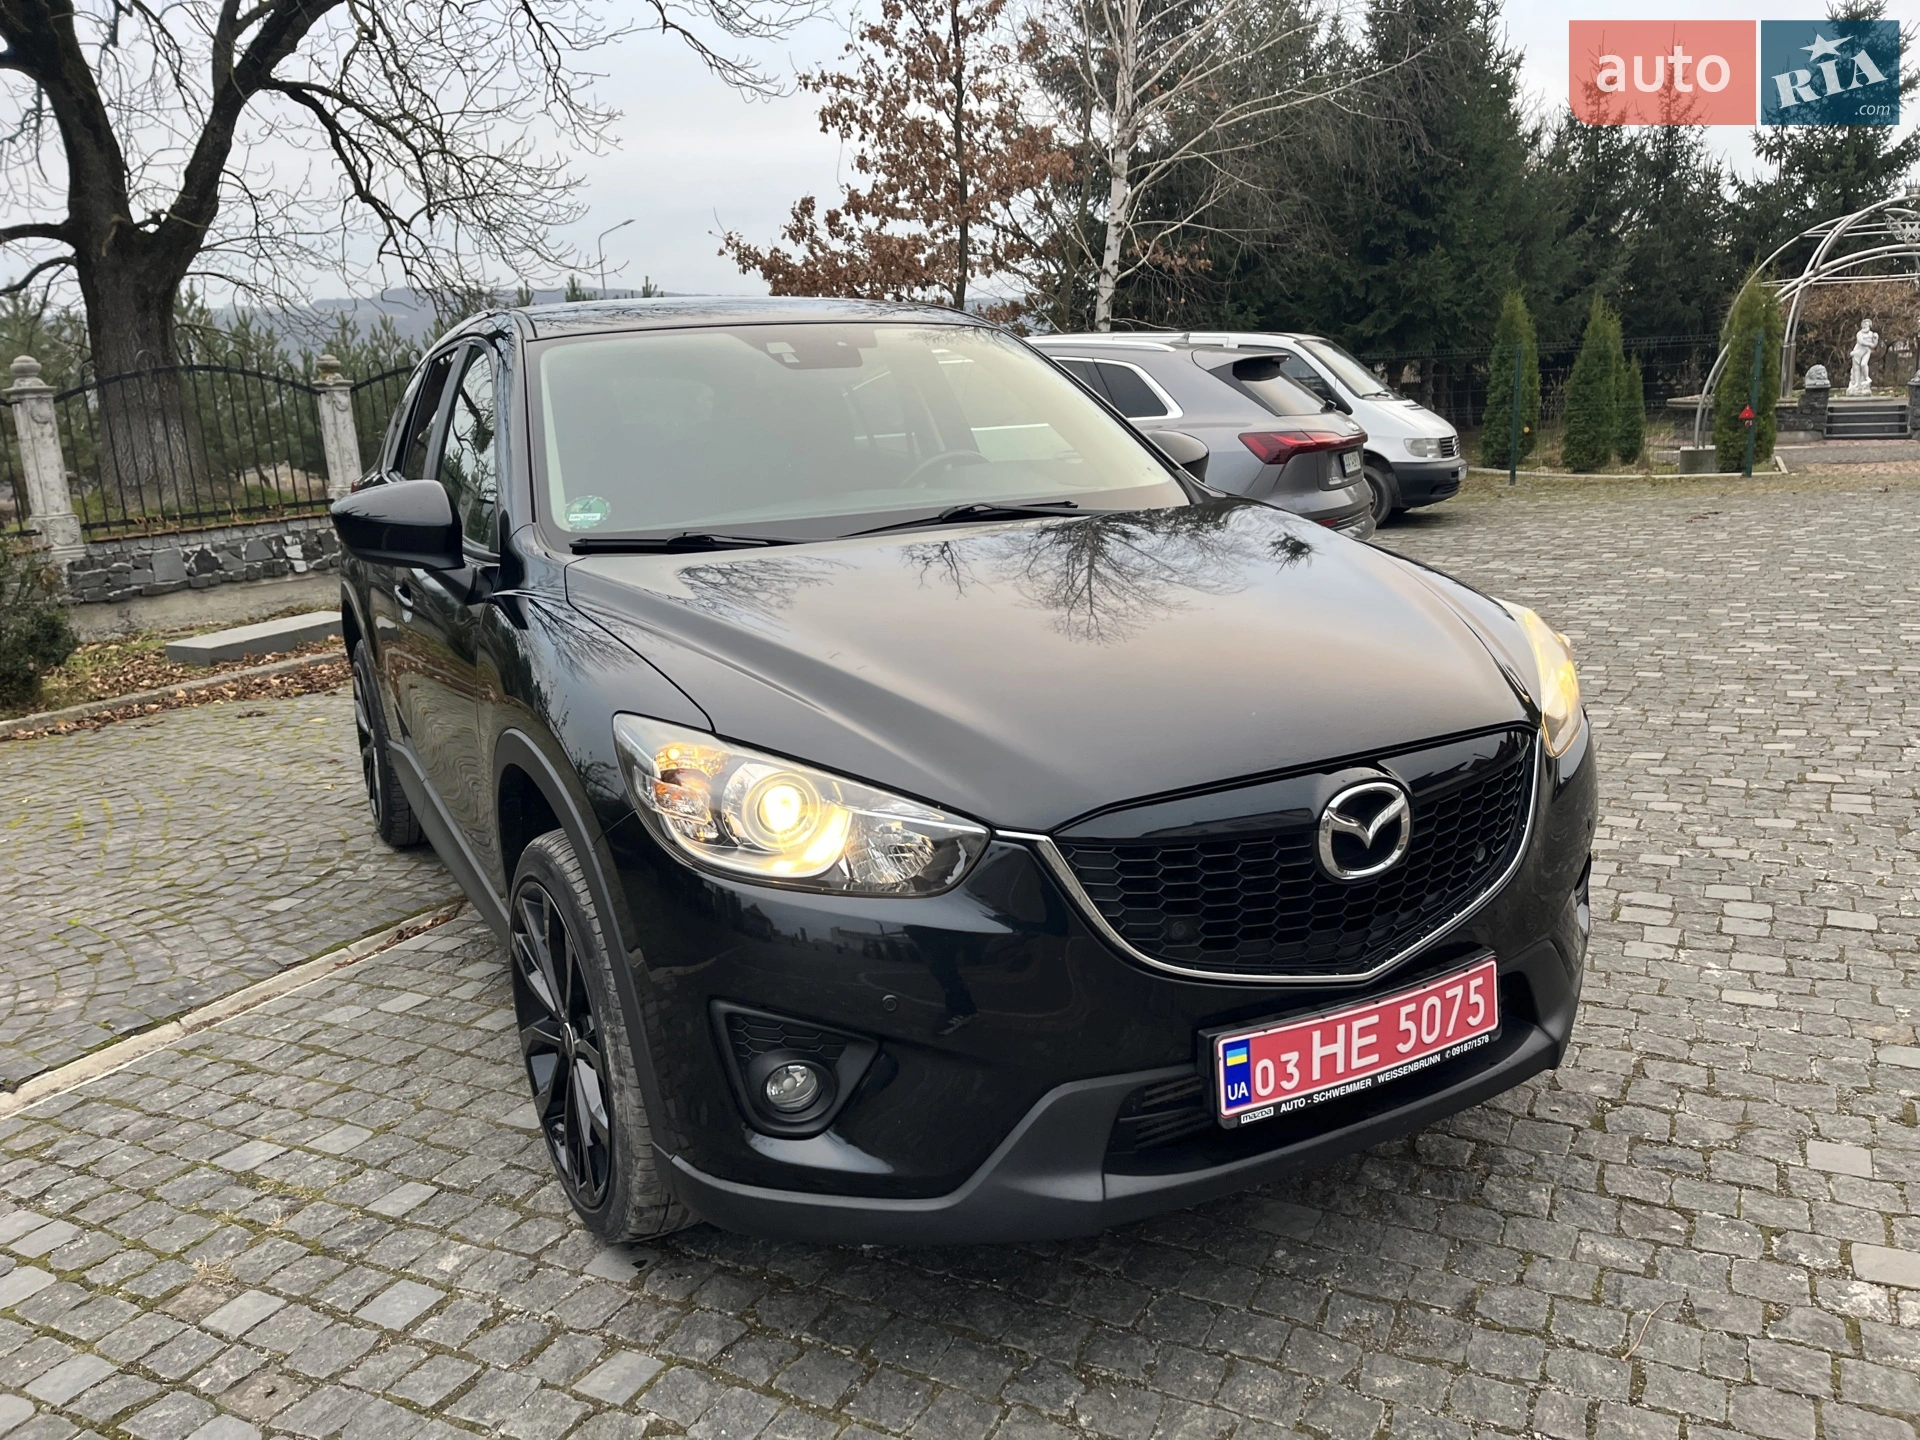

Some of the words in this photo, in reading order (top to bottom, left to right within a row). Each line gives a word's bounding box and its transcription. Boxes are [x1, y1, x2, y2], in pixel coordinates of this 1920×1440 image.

[1255, 1051, 1300, 1097] 03
[1311, 1014, 1380, 1081] HE
[1396, 976, 1485, 1054] 5075
[1227, 1081, 1249, 1101] UA
[1280, 1097, 1306, 1114] AUTO
[1313, 1078, 1372, 1104] SCHWEMMER
[1377, 1053, 1441, 1084] WEISSENBRUNN
